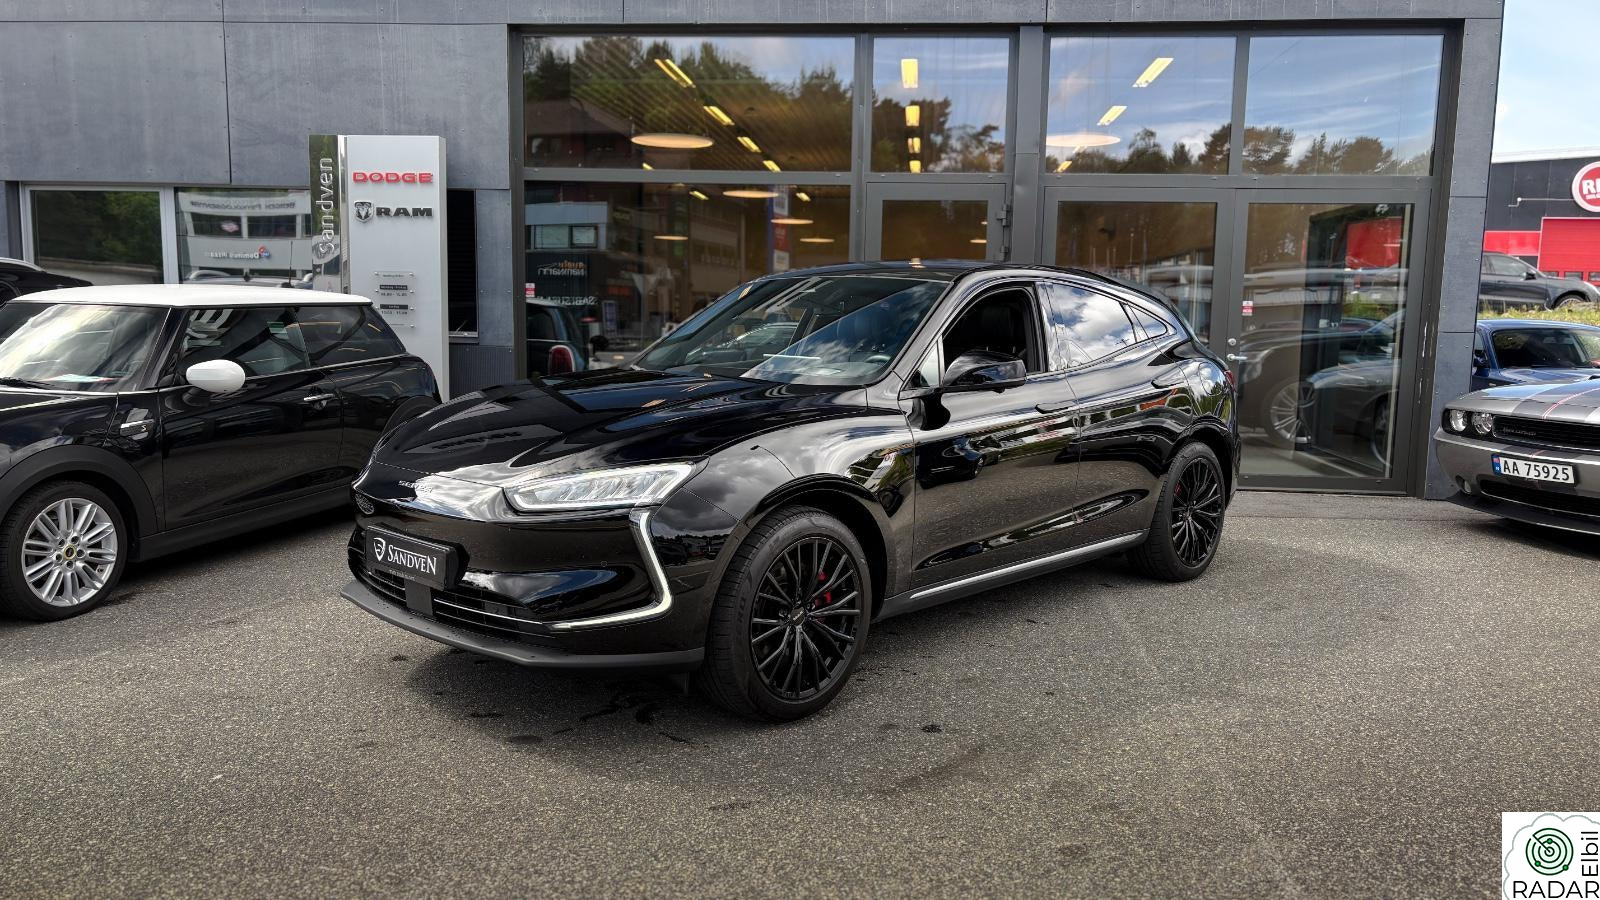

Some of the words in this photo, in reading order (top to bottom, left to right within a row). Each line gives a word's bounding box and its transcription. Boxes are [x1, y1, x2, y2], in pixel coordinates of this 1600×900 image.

[352, 172, 433, 184] DODGE
[315, 157, 335, 254] Sandven
[375, 206, 433, 217] RAM
[1503, 460, 1520, 475] AA
[1524, 462, 1570, 481] 75925
[387, 544, 437, 576] SANDVEN
